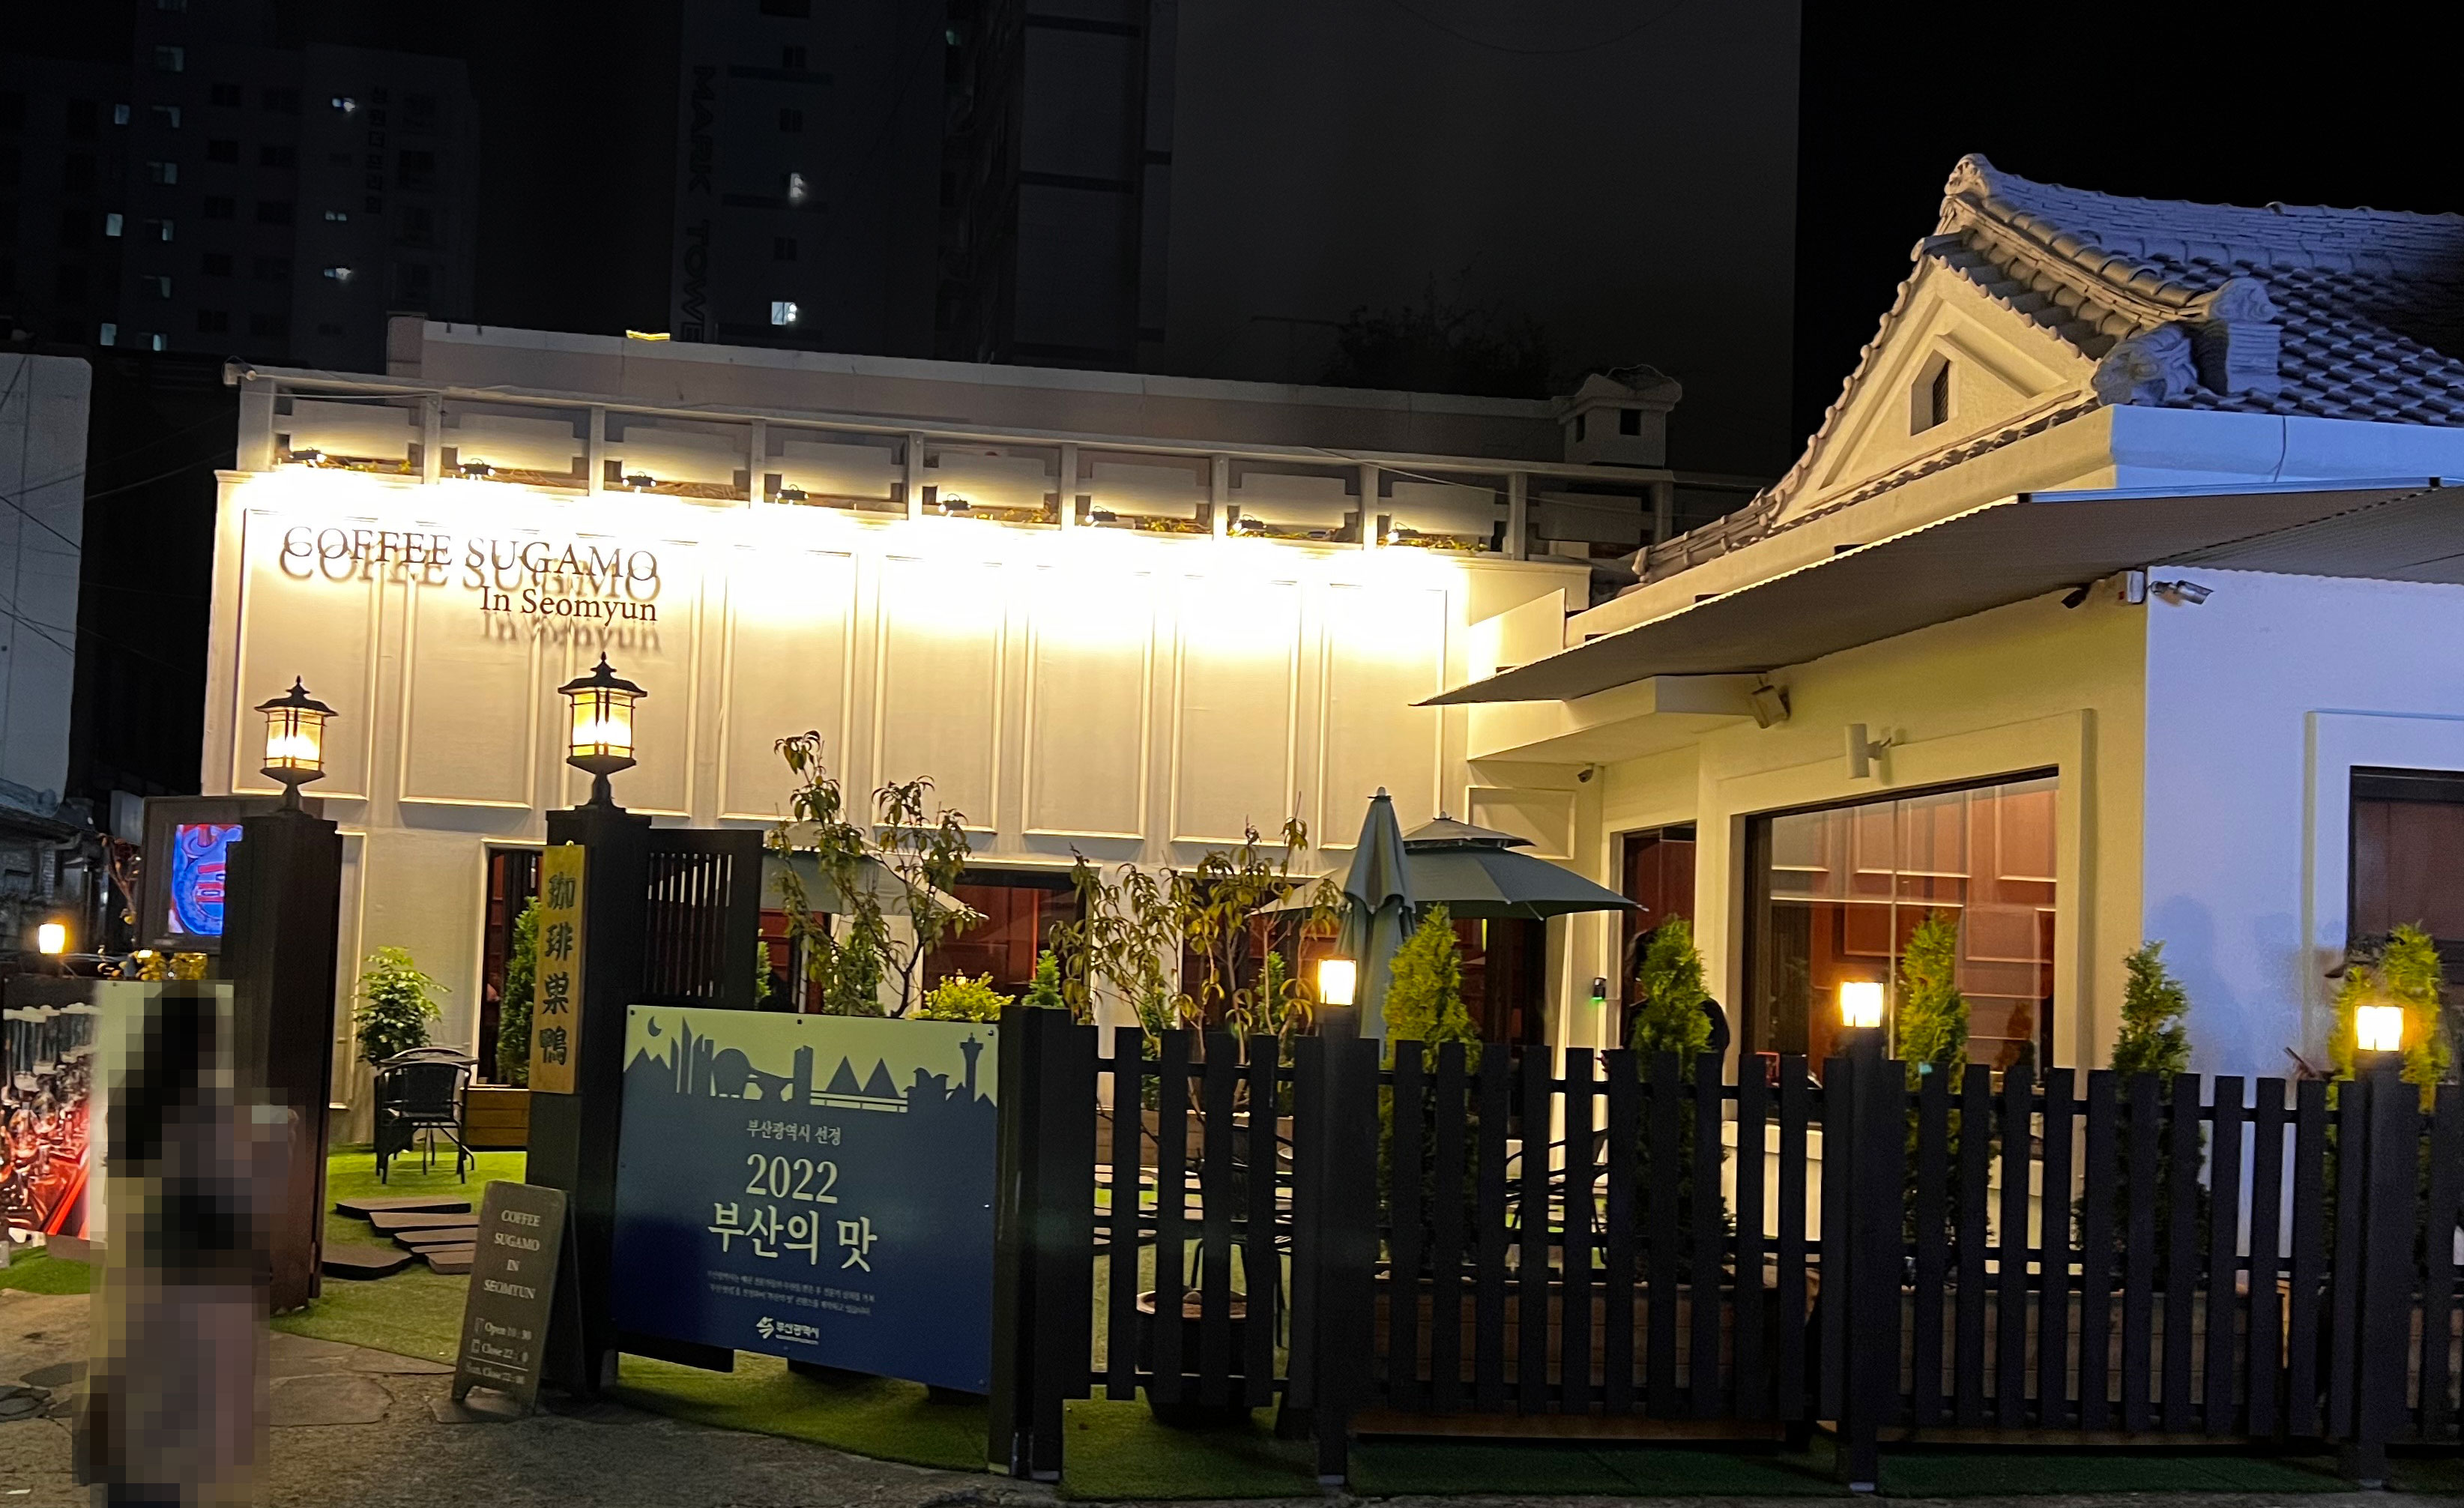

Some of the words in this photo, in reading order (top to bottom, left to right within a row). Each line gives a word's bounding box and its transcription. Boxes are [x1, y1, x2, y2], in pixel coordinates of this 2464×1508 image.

[689, 66, 715, 194] MARK
[284, 525, 452, 567] COFFEE
[465, 537, 658, 582] SUGAMO
[480, 585, 512, 612] In
[521, 588, 657, 627] Seomyun
[746, 1119, 810, 1142] 부산광역시
[746, 1153, 838, 1204] 2022
[501, 1210, 540, 1227] COFFEE
[495, 1232, 540, 1251] SUGAMO
[708, 1202, 819, 1265] 부산의
[836, 1216, 878, 1272] 맛
[507, 1259, 520, 1271] IN
[485, 1321, 506, 1336] Open
